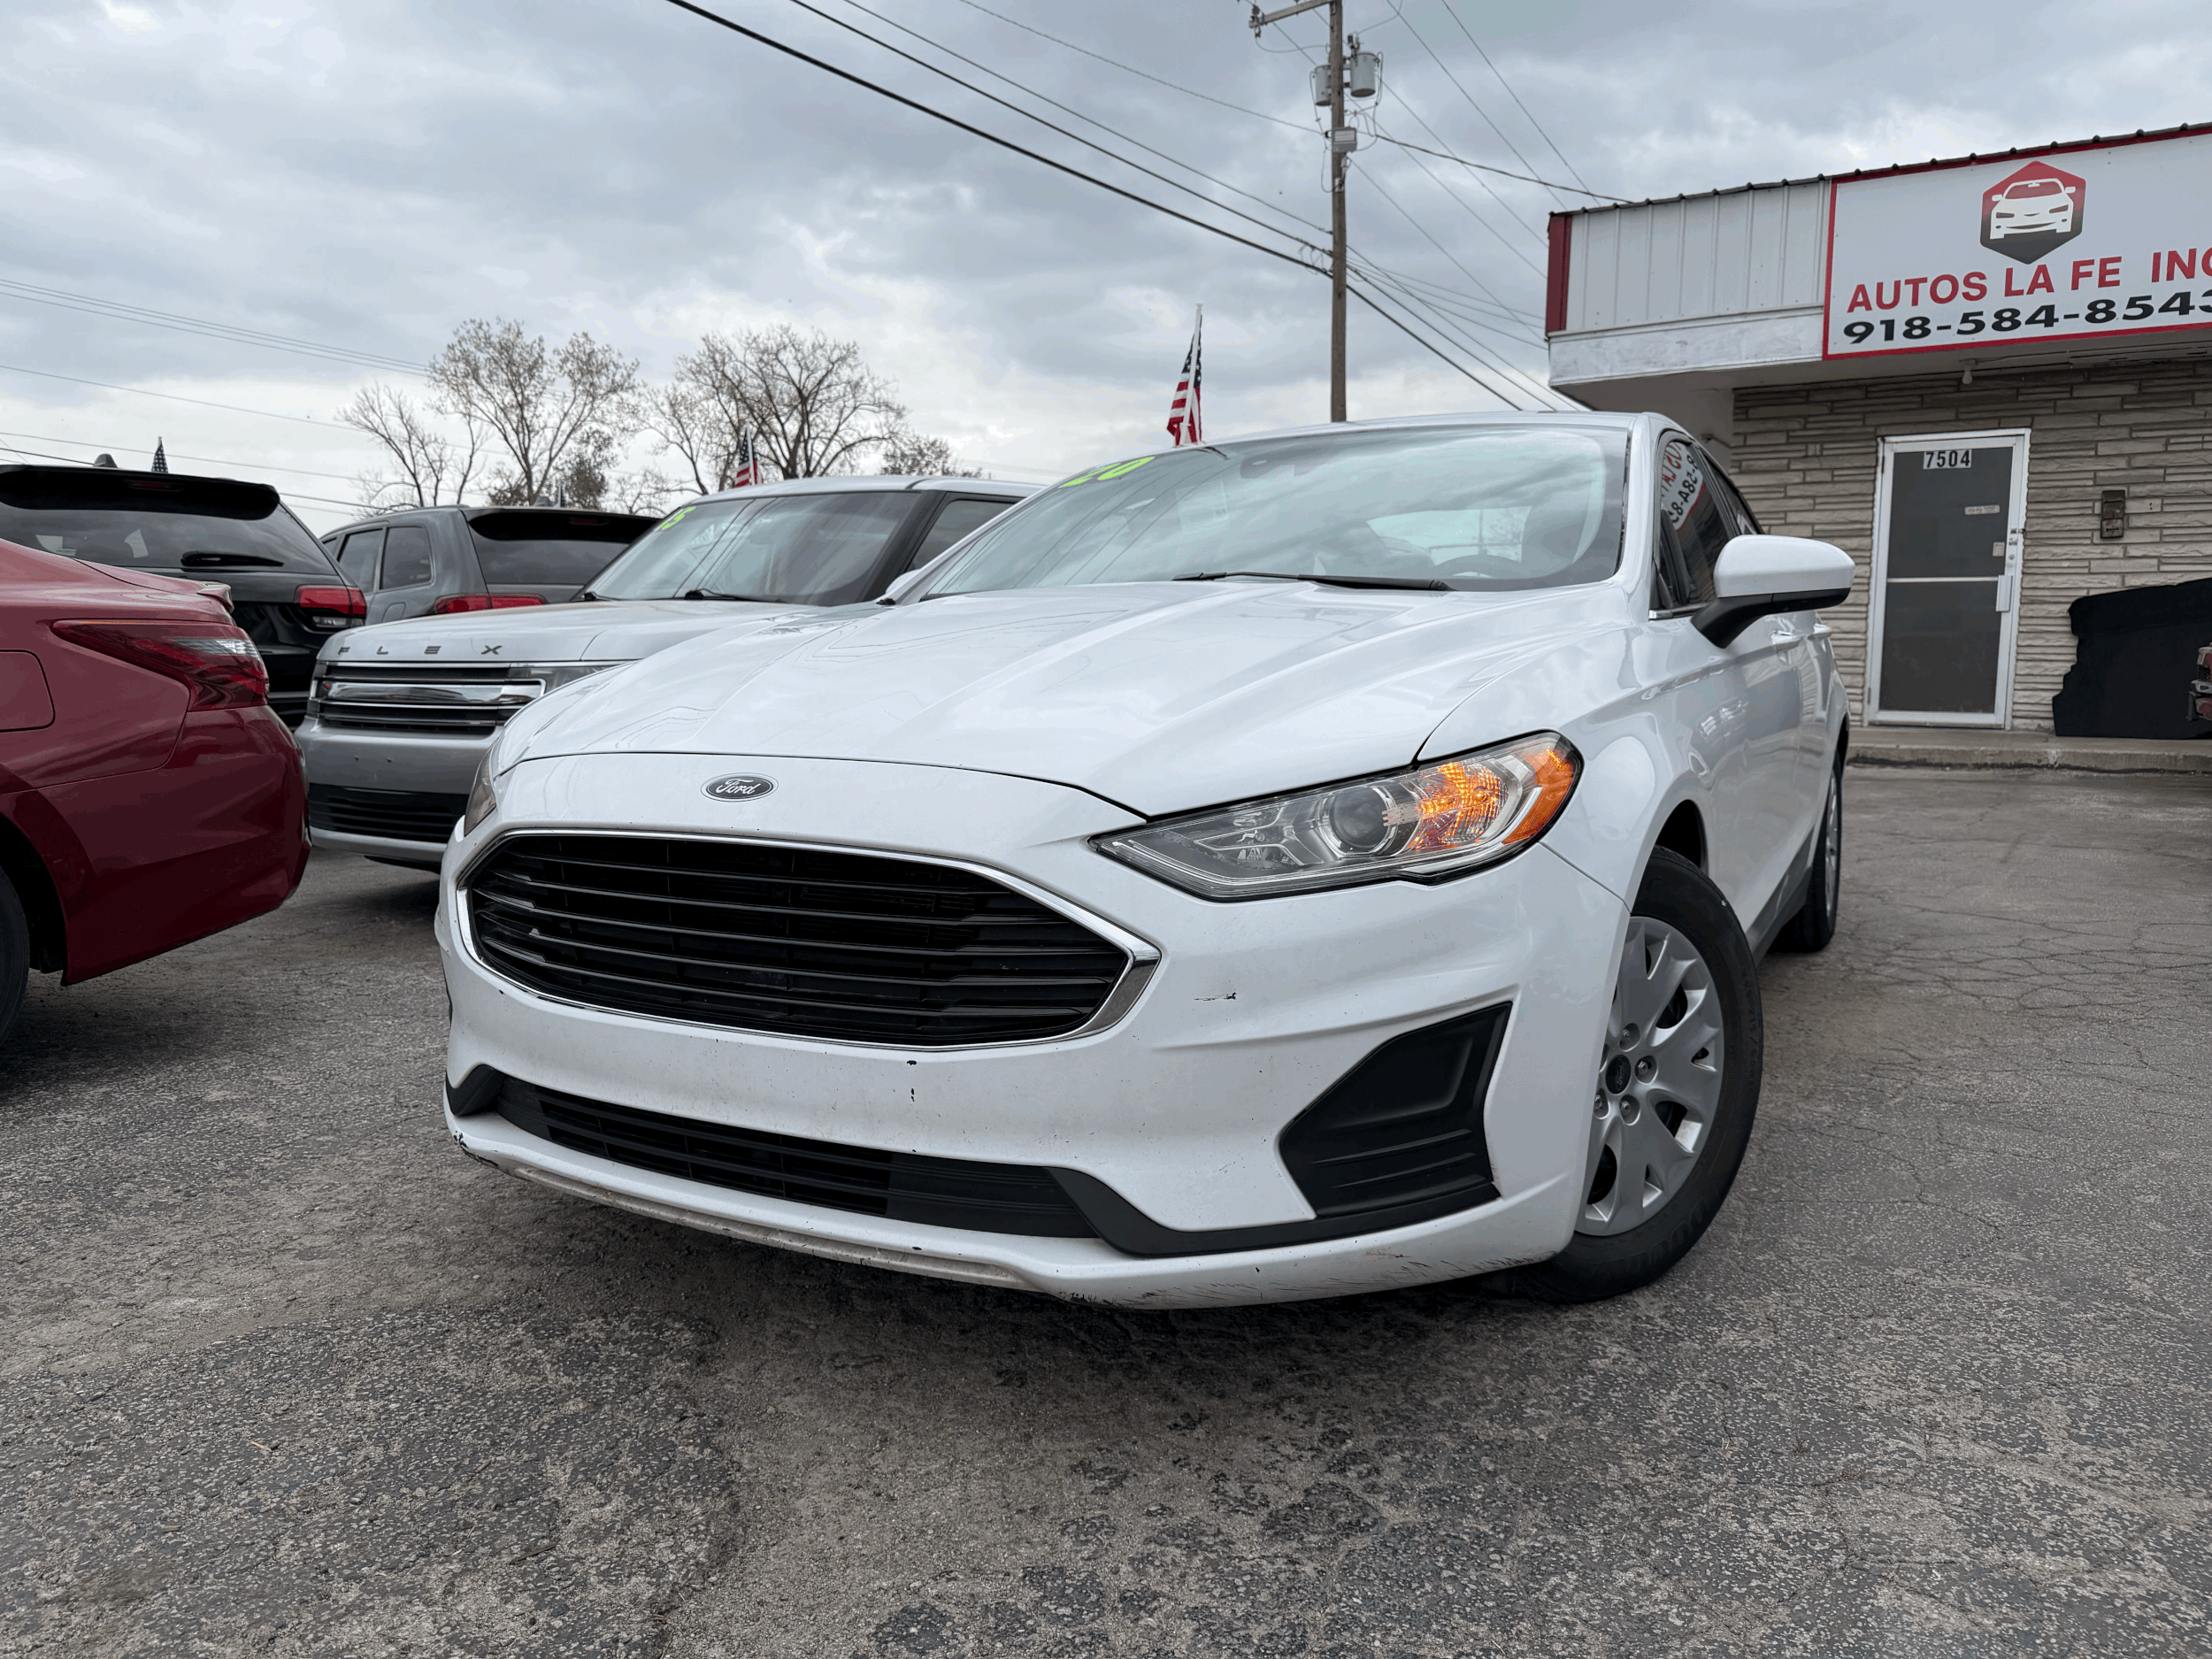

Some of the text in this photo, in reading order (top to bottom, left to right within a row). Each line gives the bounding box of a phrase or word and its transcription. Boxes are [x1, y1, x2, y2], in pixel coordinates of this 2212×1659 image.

[1847, 271, 1988, 313] AUTOS
[2003, 264, 2055, 297] LA
[2070, 256, 2123, 291] FE
[1925, 449, 1970, 468] 7504
[337, 645, 503, 656] FLEX
[715, 778, 762, 795] Ford
